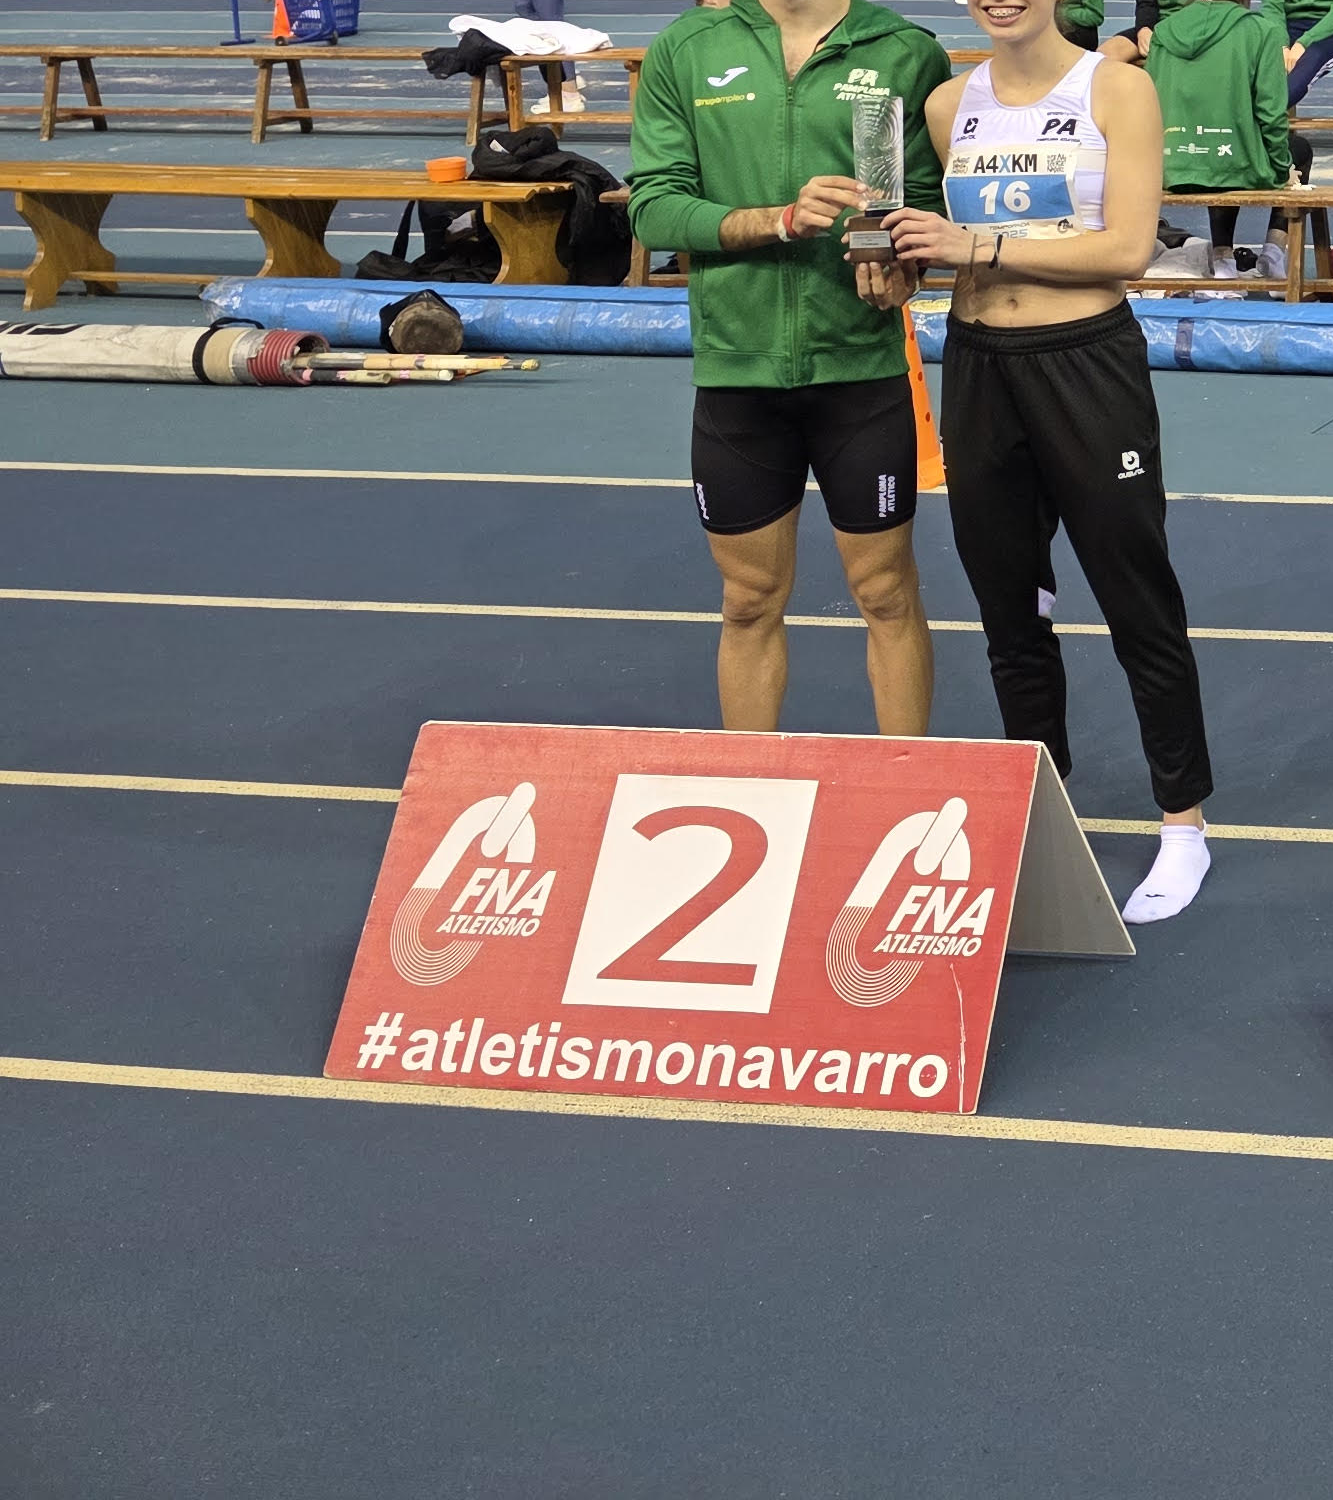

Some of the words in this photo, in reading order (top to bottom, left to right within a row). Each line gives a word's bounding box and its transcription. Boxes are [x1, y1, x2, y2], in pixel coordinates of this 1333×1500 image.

[833, 82, 890, 97] PAMPLONA
[1041, 118, 1077, 136] PA
[973, 153, 1038, 174] A4XKM
[979, 180, 1032, 216] 16
[878, 474, 887, 518] PAMPLONA
[451, 867, 557, 915] FNA
[596, 805, 769, 987] 2
[436, 913, 541, 938] ATLETISMO
[887, 885, 995, 935] FNA
[873, 932, 983, 957] ATLETISMO
[356, 1011, 949, 1098] #atletismonavarro
